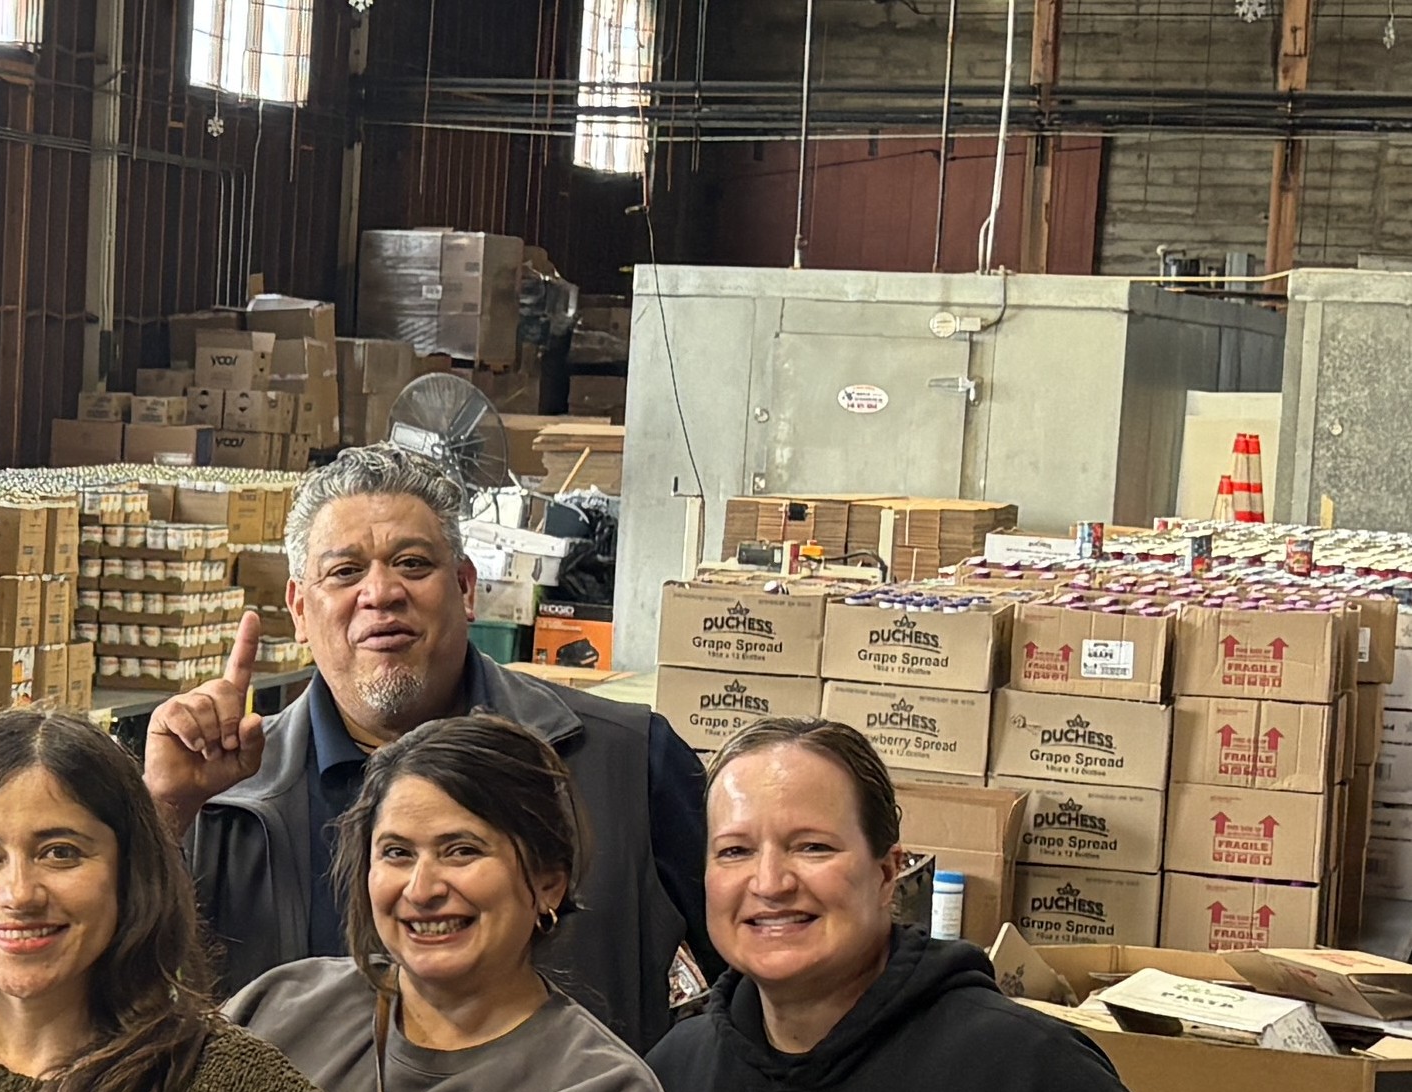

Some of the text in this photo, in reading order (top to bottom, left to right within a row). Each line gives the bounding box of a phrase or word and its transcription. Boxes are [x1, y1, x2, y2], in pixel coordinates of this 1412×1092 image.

[703, 616, 774, 634] DUCHESS
[692, 636, 783, 653] Grape Spread
[869, 629, 940, 648] DUCHESS
[857, 649, 949, 668] Grape Spread
[1227, 662, 1279, 675] FRAGILE
[700, 693, 770, 713] DUCHESS
[689, 713, 729, 729] Grape
[866, 712, 938, 732] DUCHESS
[867, 733, 957, 752] wberry Spread
[1041, 729, 1115, 750] DUCHESS
[1029, 749, 1124, 768] Grape Spread
[1033, 813, 1107, 832] DUCHESS
[1022, 832, 1118, 851] Grape Spread
[1218, 839, 1269, 852] FRAGILE
[1031, 897, 1105, 917] DUCHESS
[1020, 916, 1115, 936] Grape Spread
